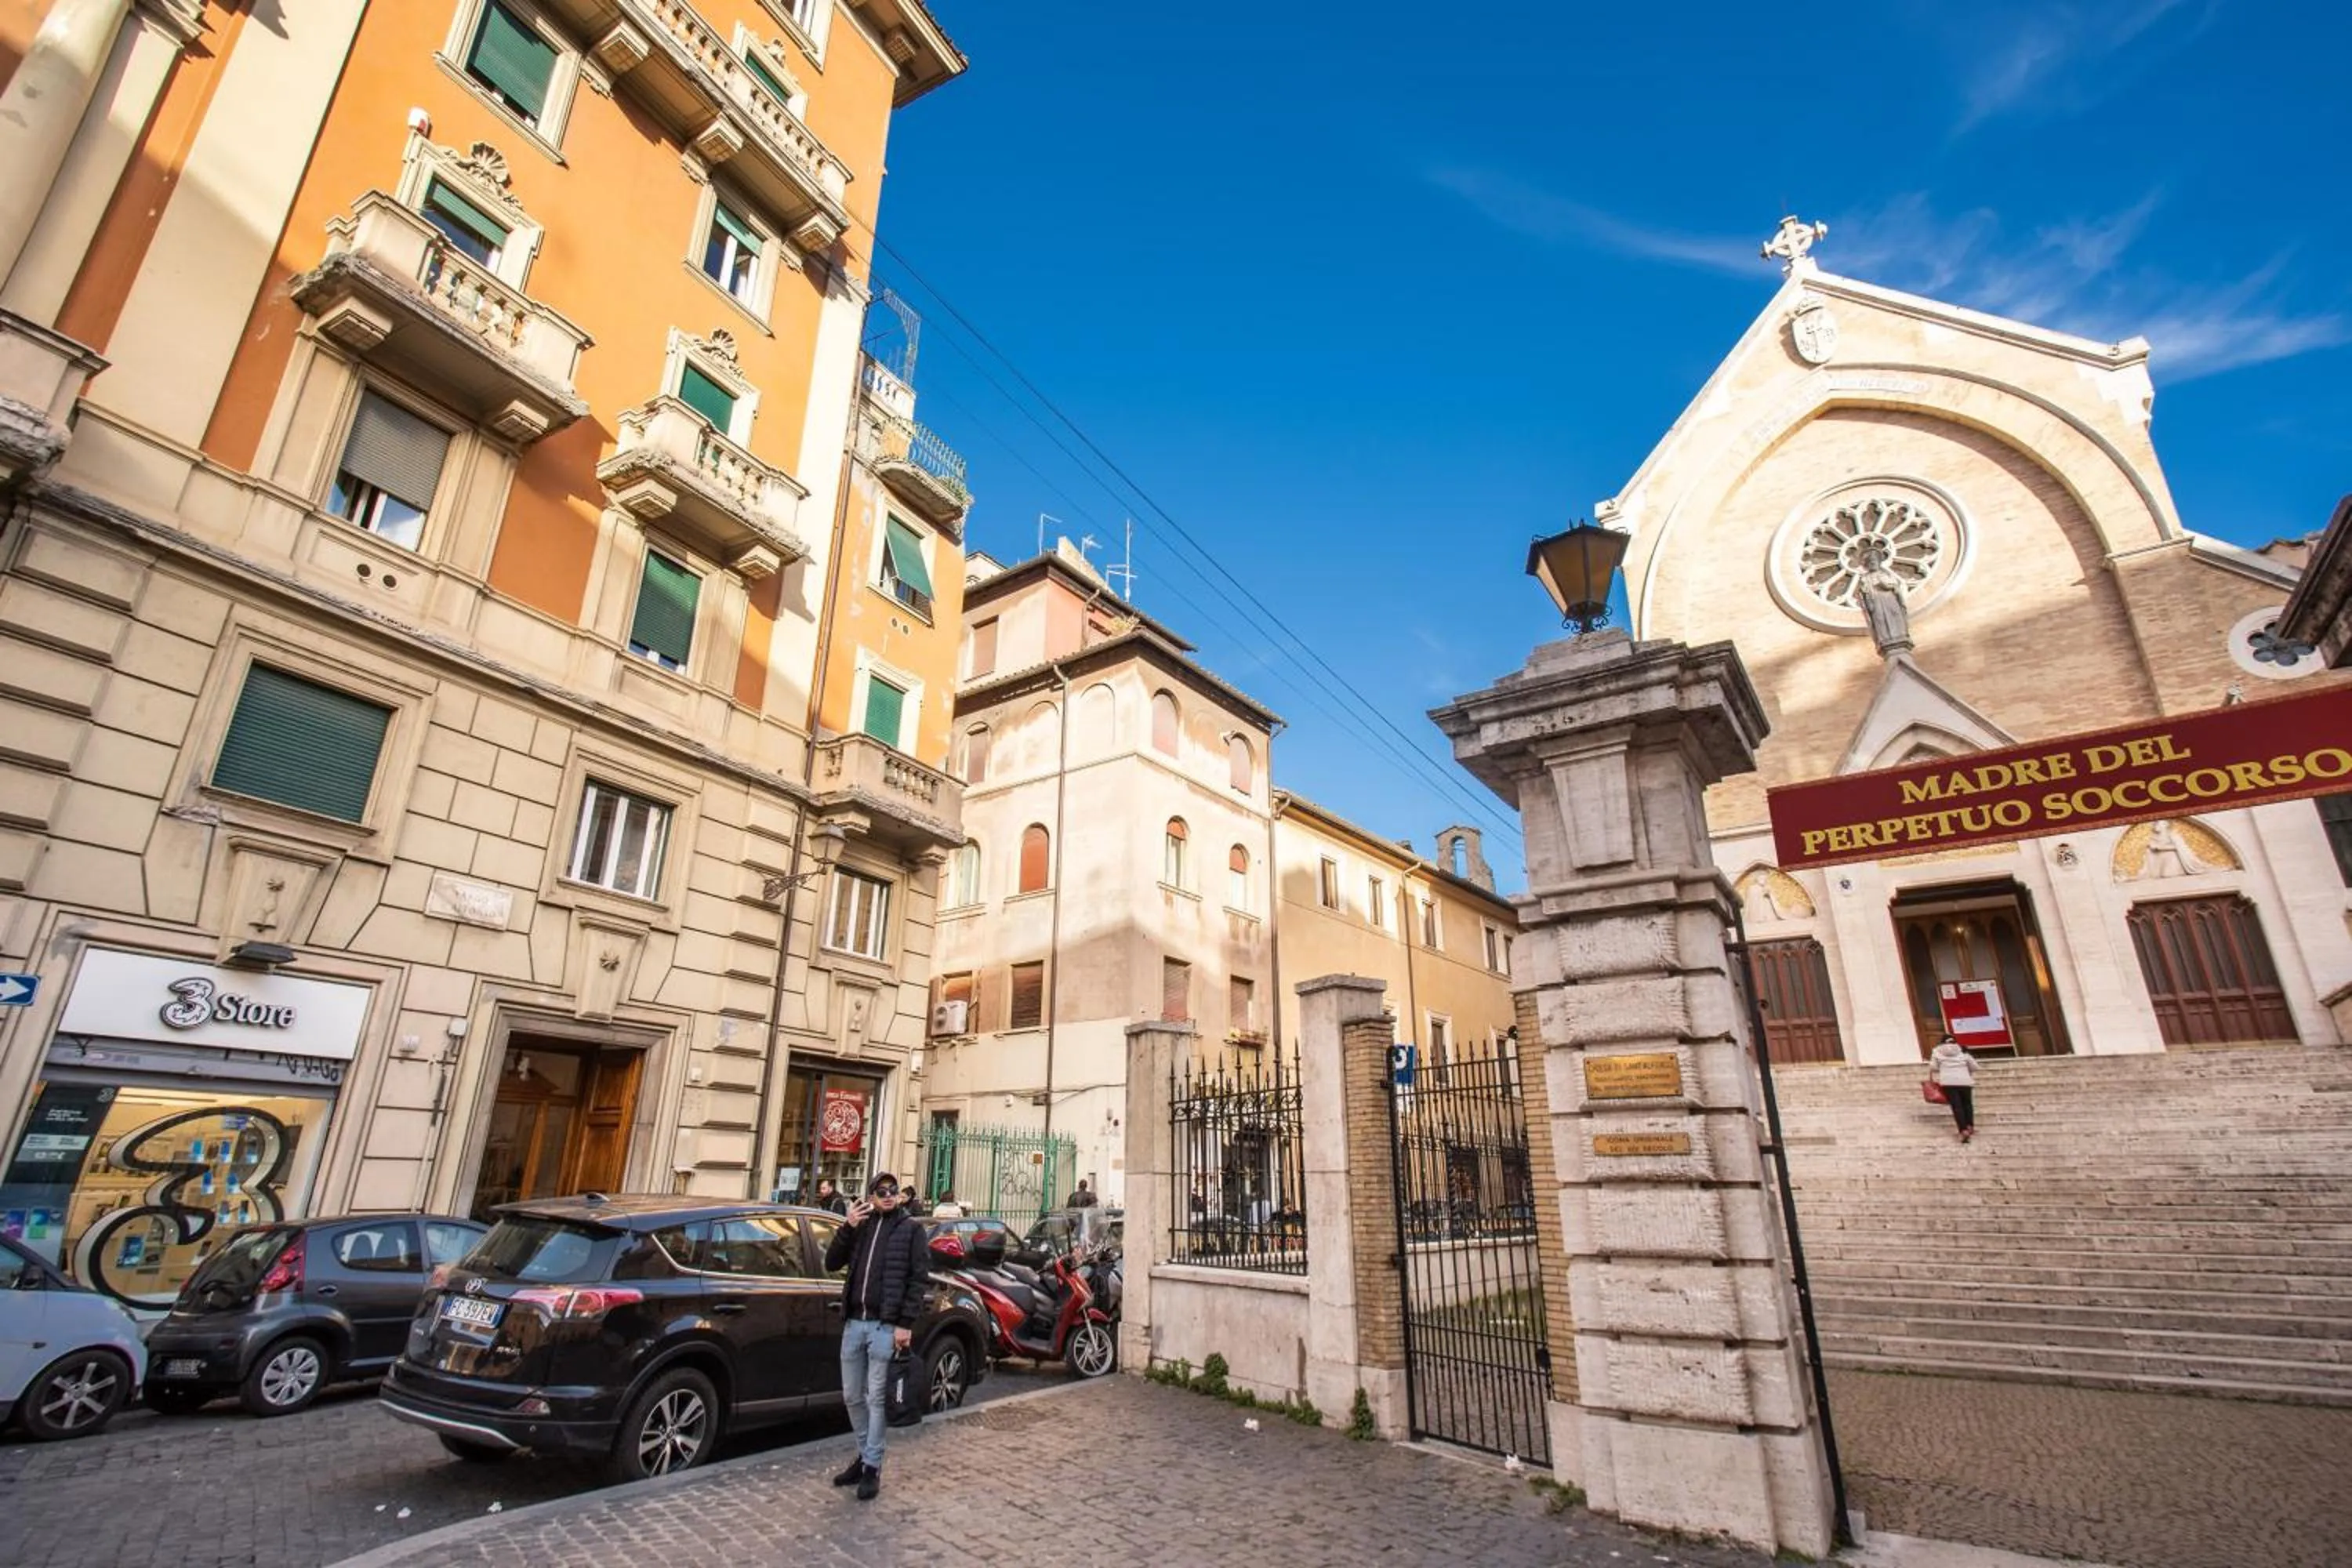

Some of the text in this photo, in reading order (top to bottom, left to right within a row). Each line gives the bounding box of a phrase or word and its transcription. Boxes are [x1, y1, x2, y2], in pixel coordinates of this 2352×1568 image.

[1801, 800, 2031, 856] PERPETUO
[2042, 748, 2352, 820] SOCCORSO
[1899, 735, 2191, 804] MADRE DEL
[213, 992, 296, 1029] Store
